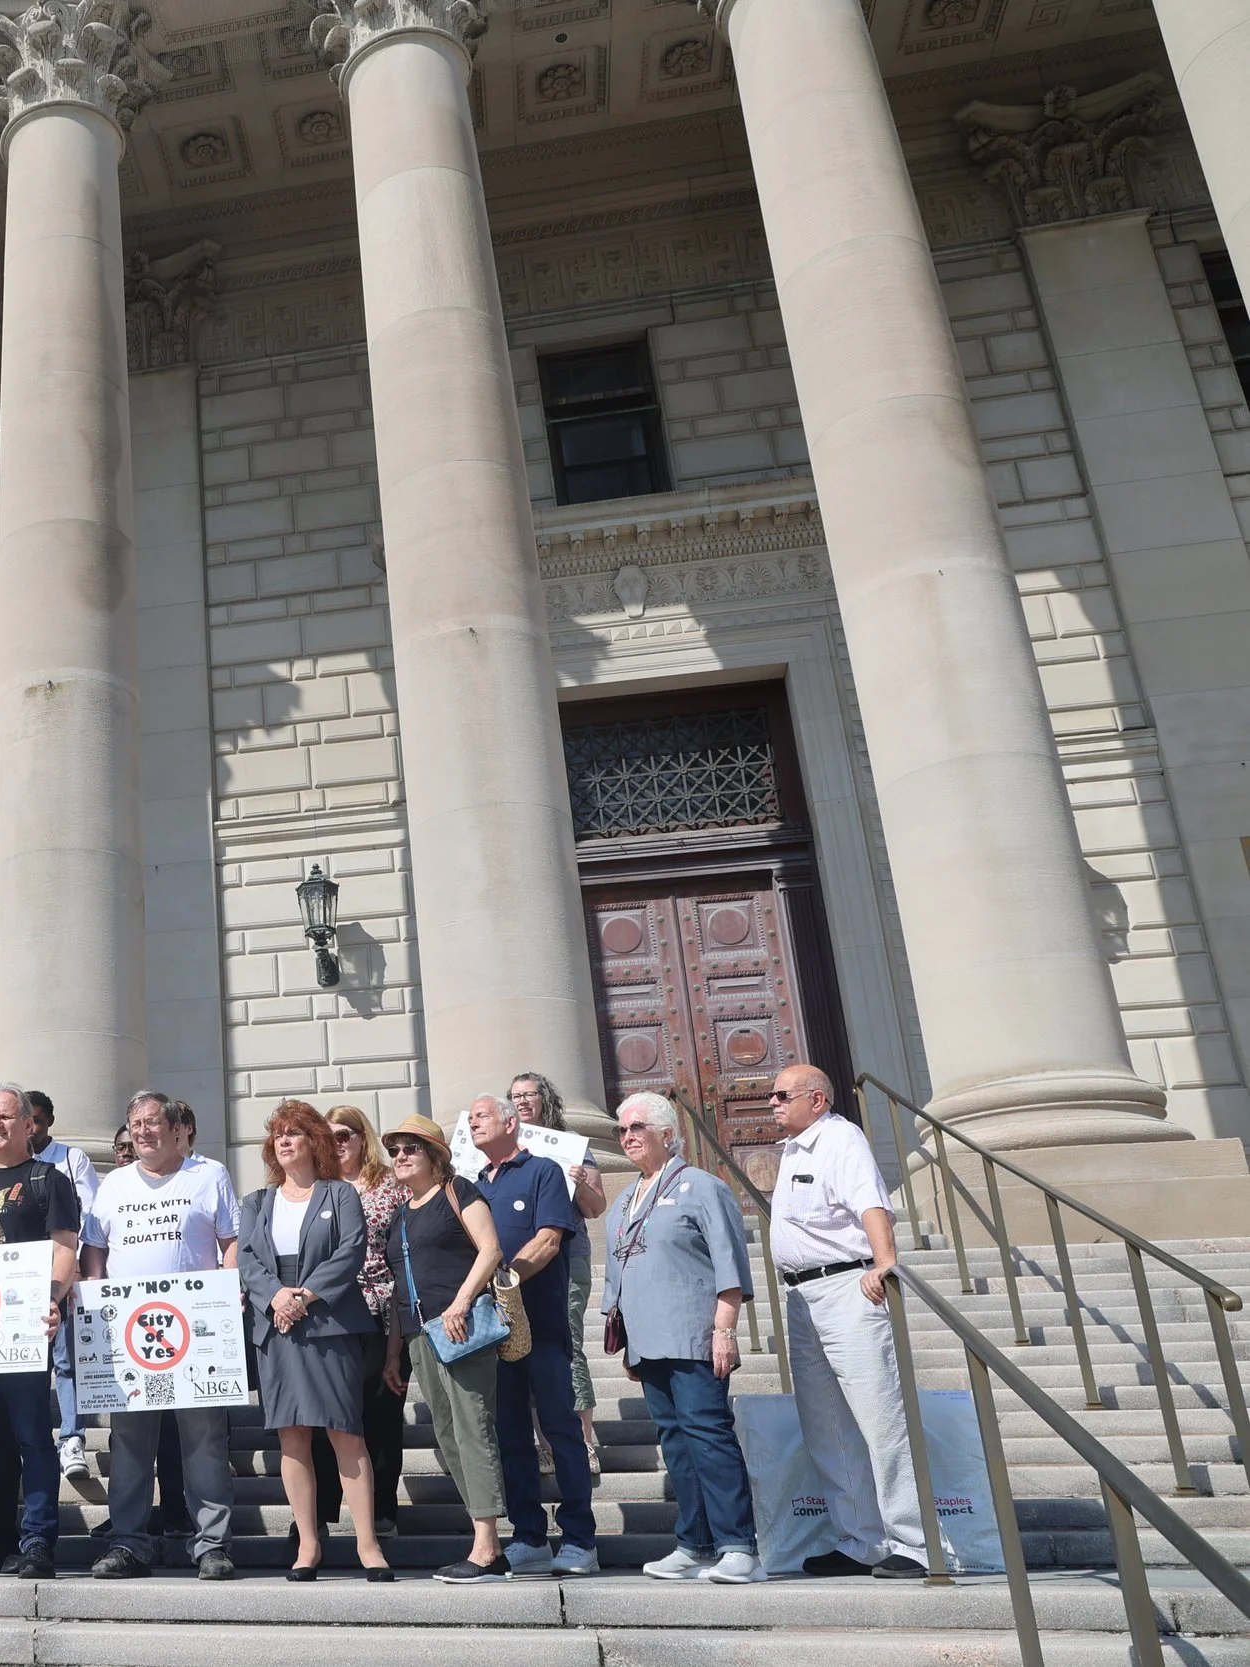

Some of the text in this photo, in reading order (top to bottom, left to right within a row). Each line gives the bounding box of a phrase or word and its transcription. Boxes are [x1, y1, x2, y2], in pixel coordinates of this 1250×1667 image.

[544, 1134, 558, 1145] to
[118, 1199, 191, 1213] STUCK WITH
[148, 1214, 178, 1225] YEAR
[123, 1232, 182, 1245] SQUATTER
[3, 1251, 19, 1261] to
[101, 1279, 204, 1298] Say "NO" to
[137, 1314, 174, 1327] City
[145, 1329, 164, 1343] of
[141, 1346, 175, 1359] Yes
[194, 1380, 242, 1396] NBCA
[806, 1496, 826, 1506] Stap
[934, 1496, 971, 1507] Staples
[793, 1506, 829, 1516] Conne
[936, 1506, 974, 1516] nnect
